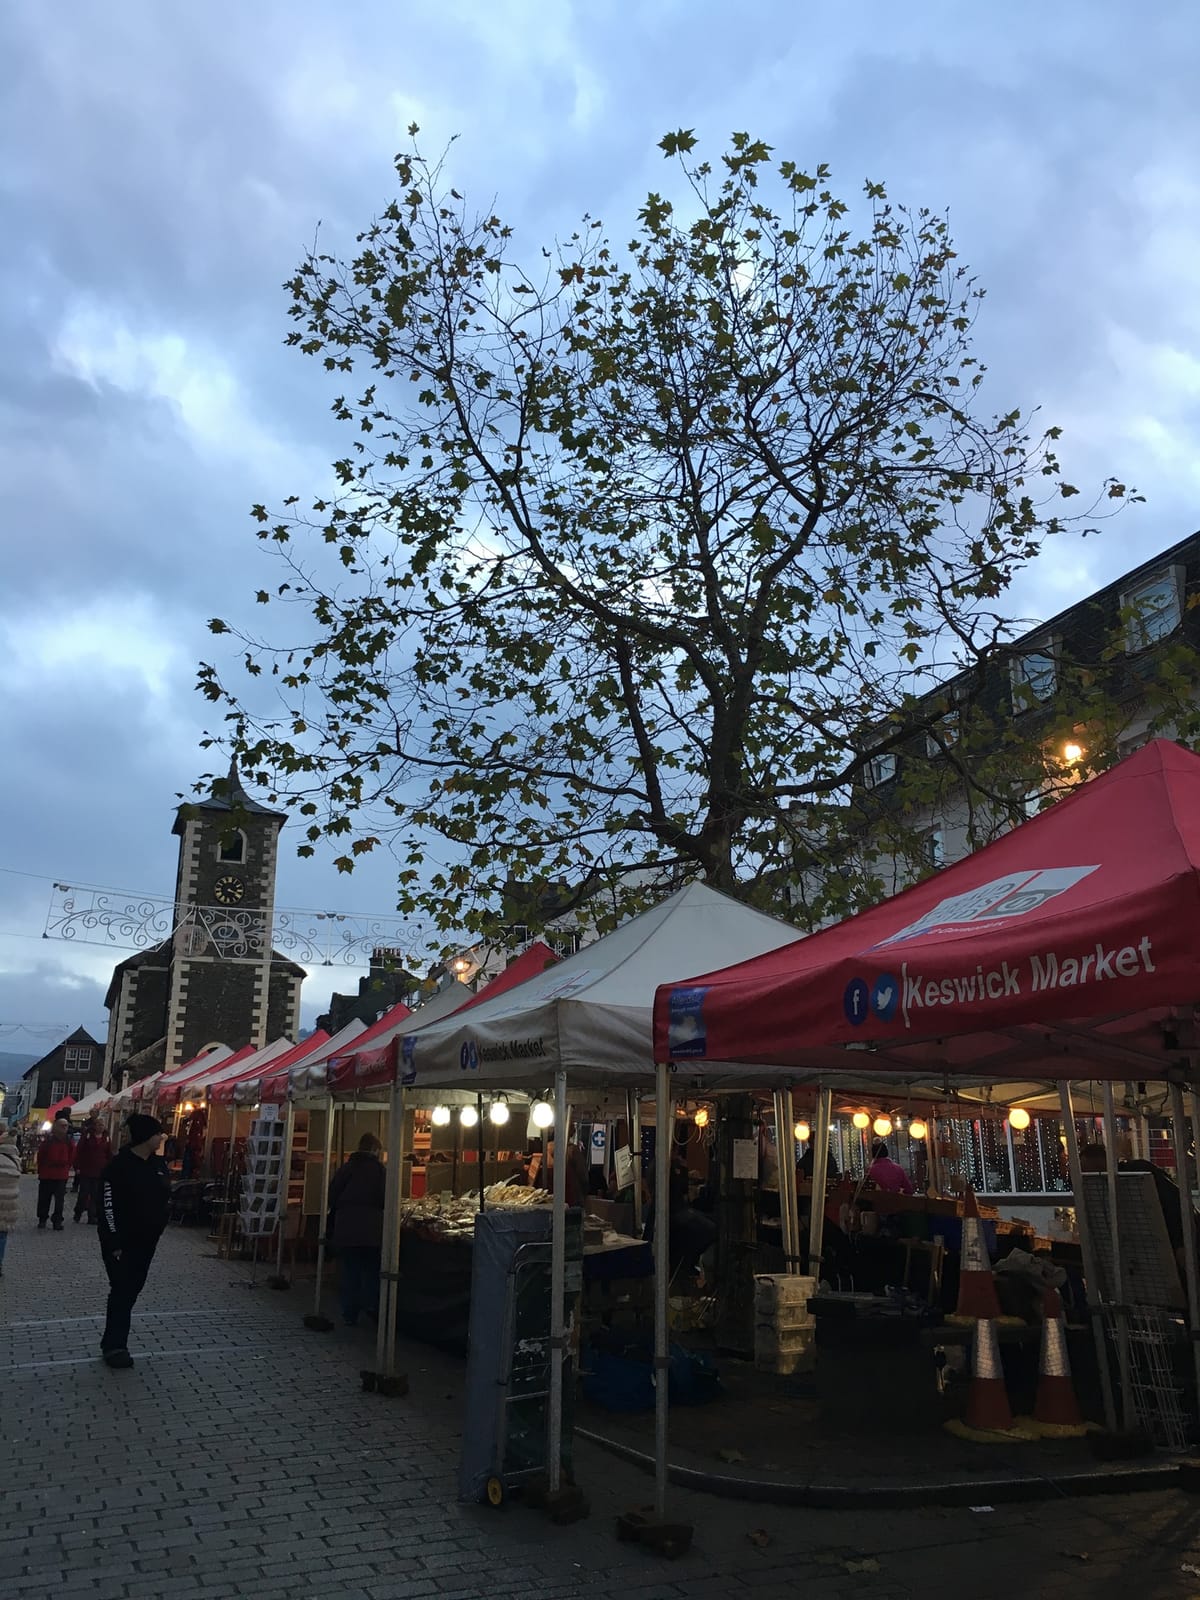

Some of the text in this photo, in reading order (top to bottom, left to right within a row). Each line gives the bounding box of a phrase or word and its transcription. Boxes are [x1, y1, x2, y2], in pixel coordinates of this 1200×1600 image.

[907, 936, 1156, 1009] Keswick Market
[511, 1037, 546, 1060] Market
